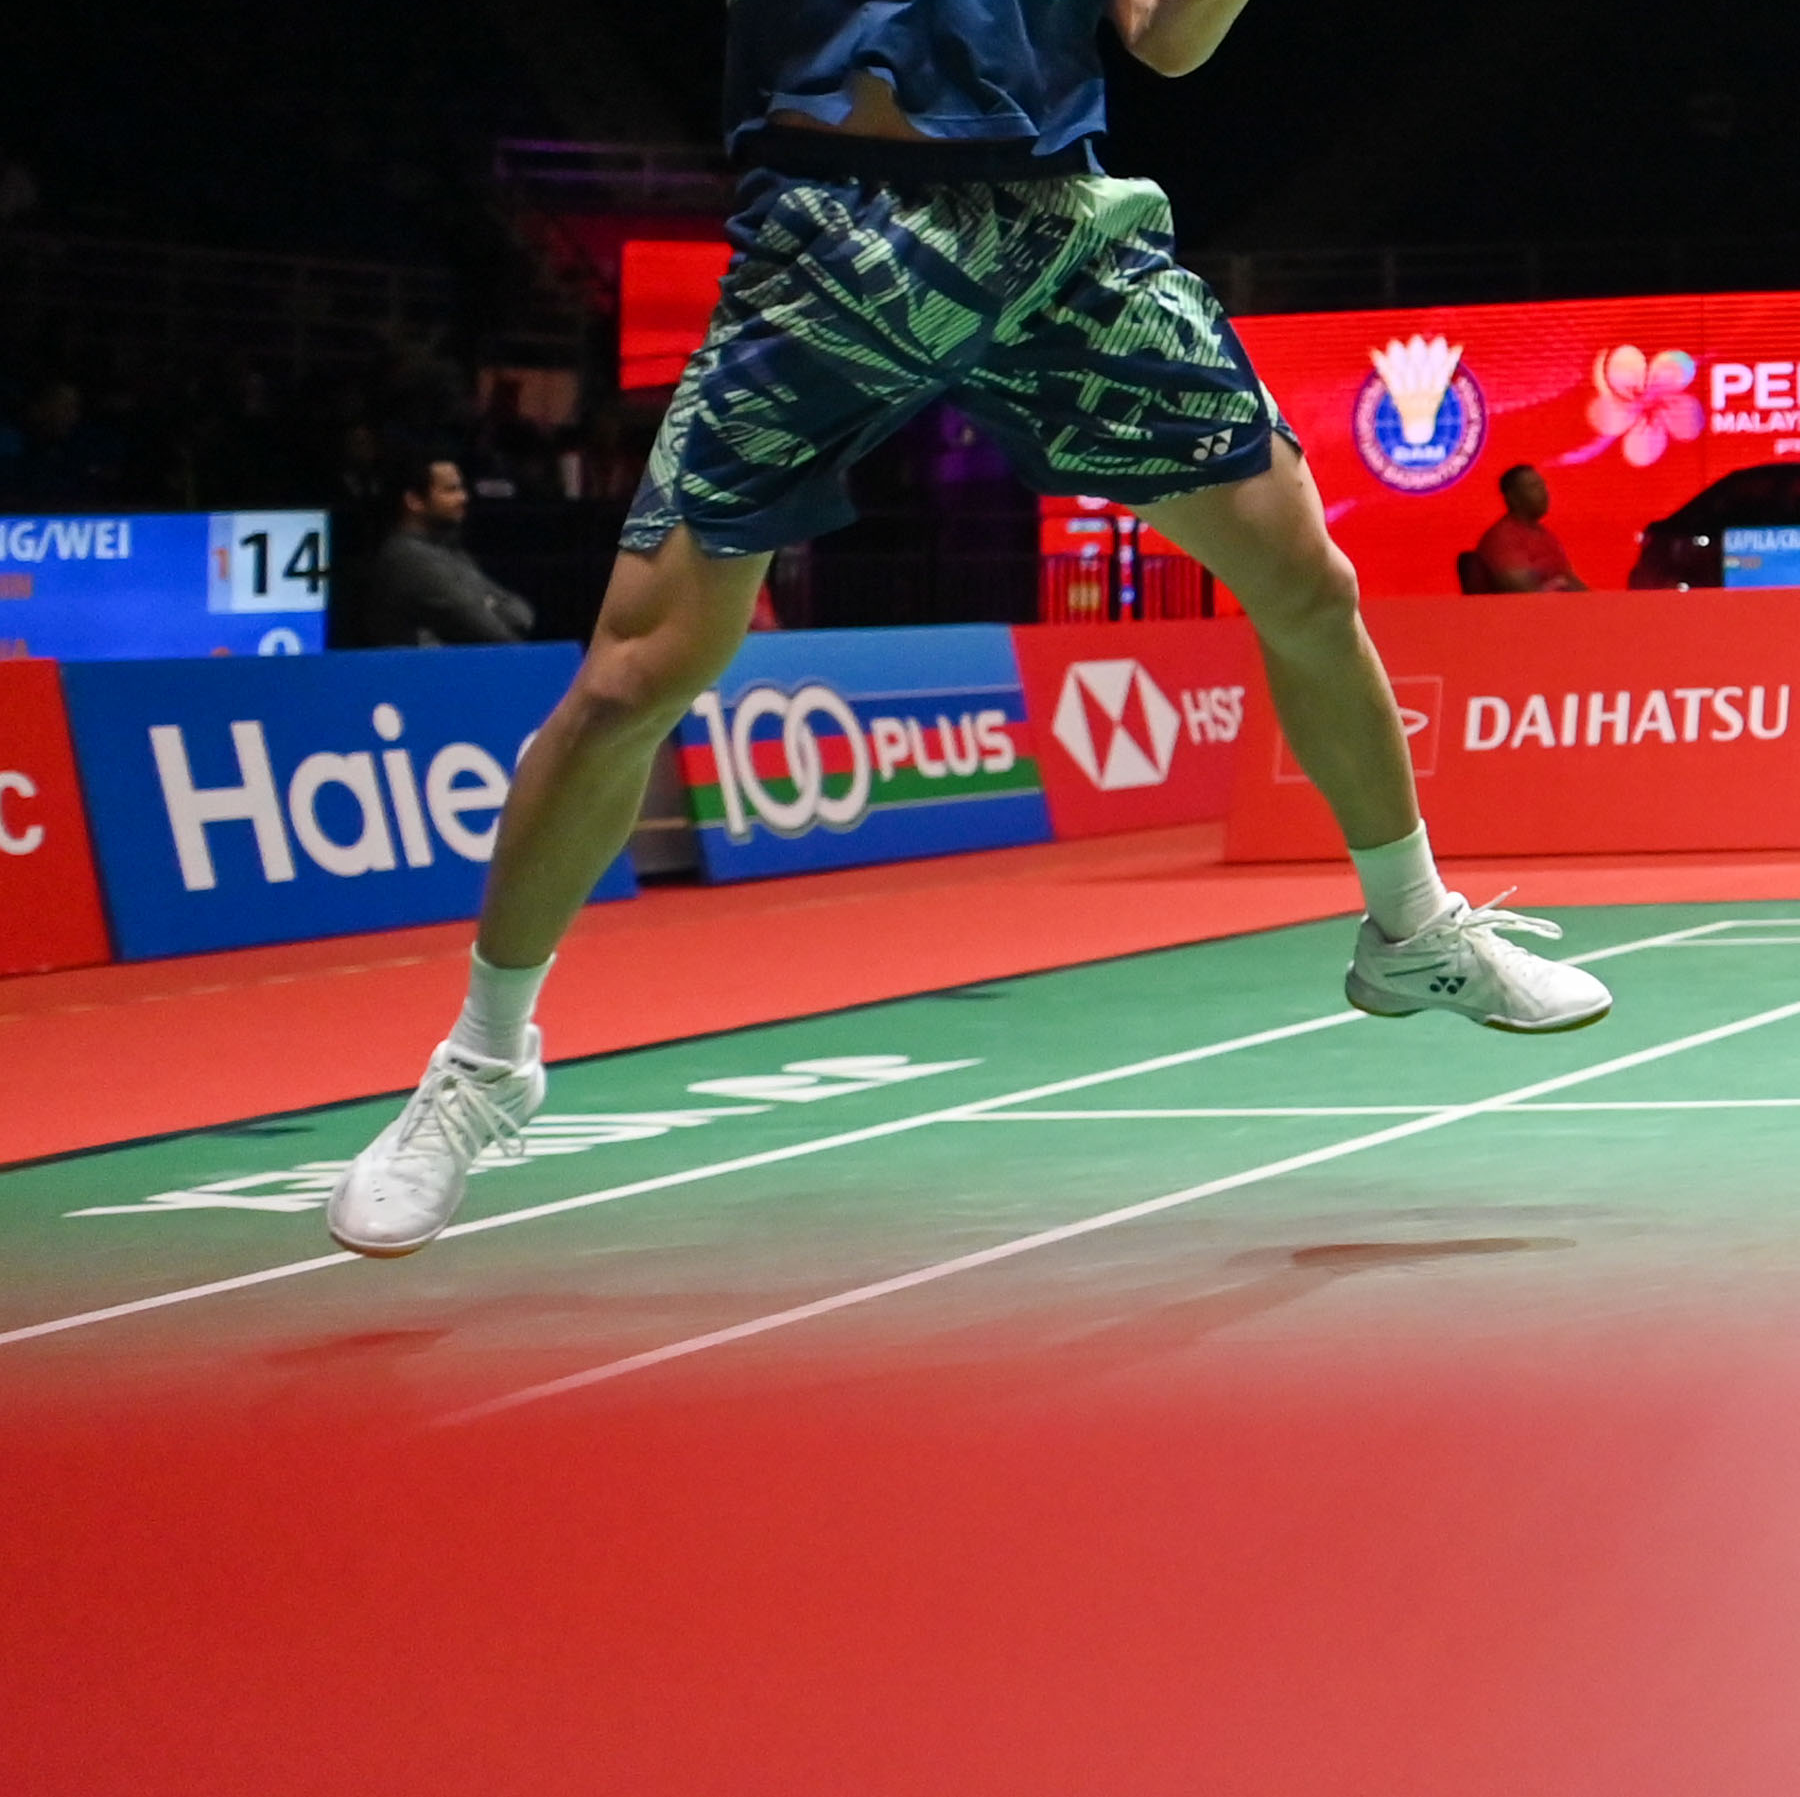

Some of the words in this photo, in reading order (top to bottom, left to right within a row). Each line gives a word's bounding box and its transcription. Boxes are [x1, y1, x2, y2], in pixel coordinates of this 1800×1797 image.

[239, 530, 329, 596] 14
[1463, 685, 1791, 752] DAIHATSU
[149, 702, 540, 892] Haie
